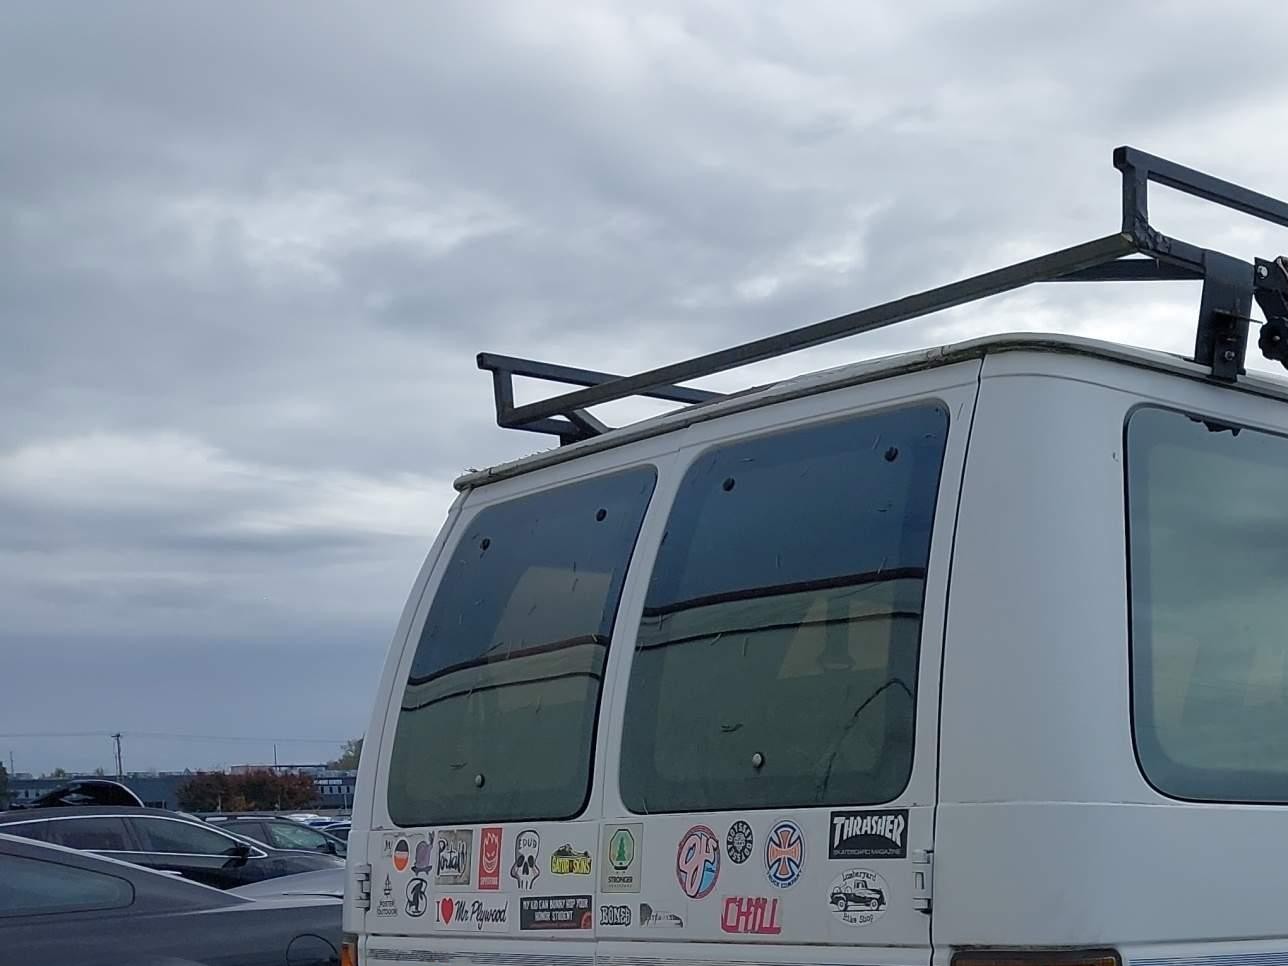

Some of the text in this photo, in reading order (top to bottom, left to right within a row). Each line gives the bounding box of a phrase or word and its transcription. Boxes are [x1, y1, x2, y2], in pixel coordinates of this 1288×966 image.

[833, 814, 905, 849] THRASHER
[436, 901, 440, 923] I
[721, 897, 782, 934] CHILL
